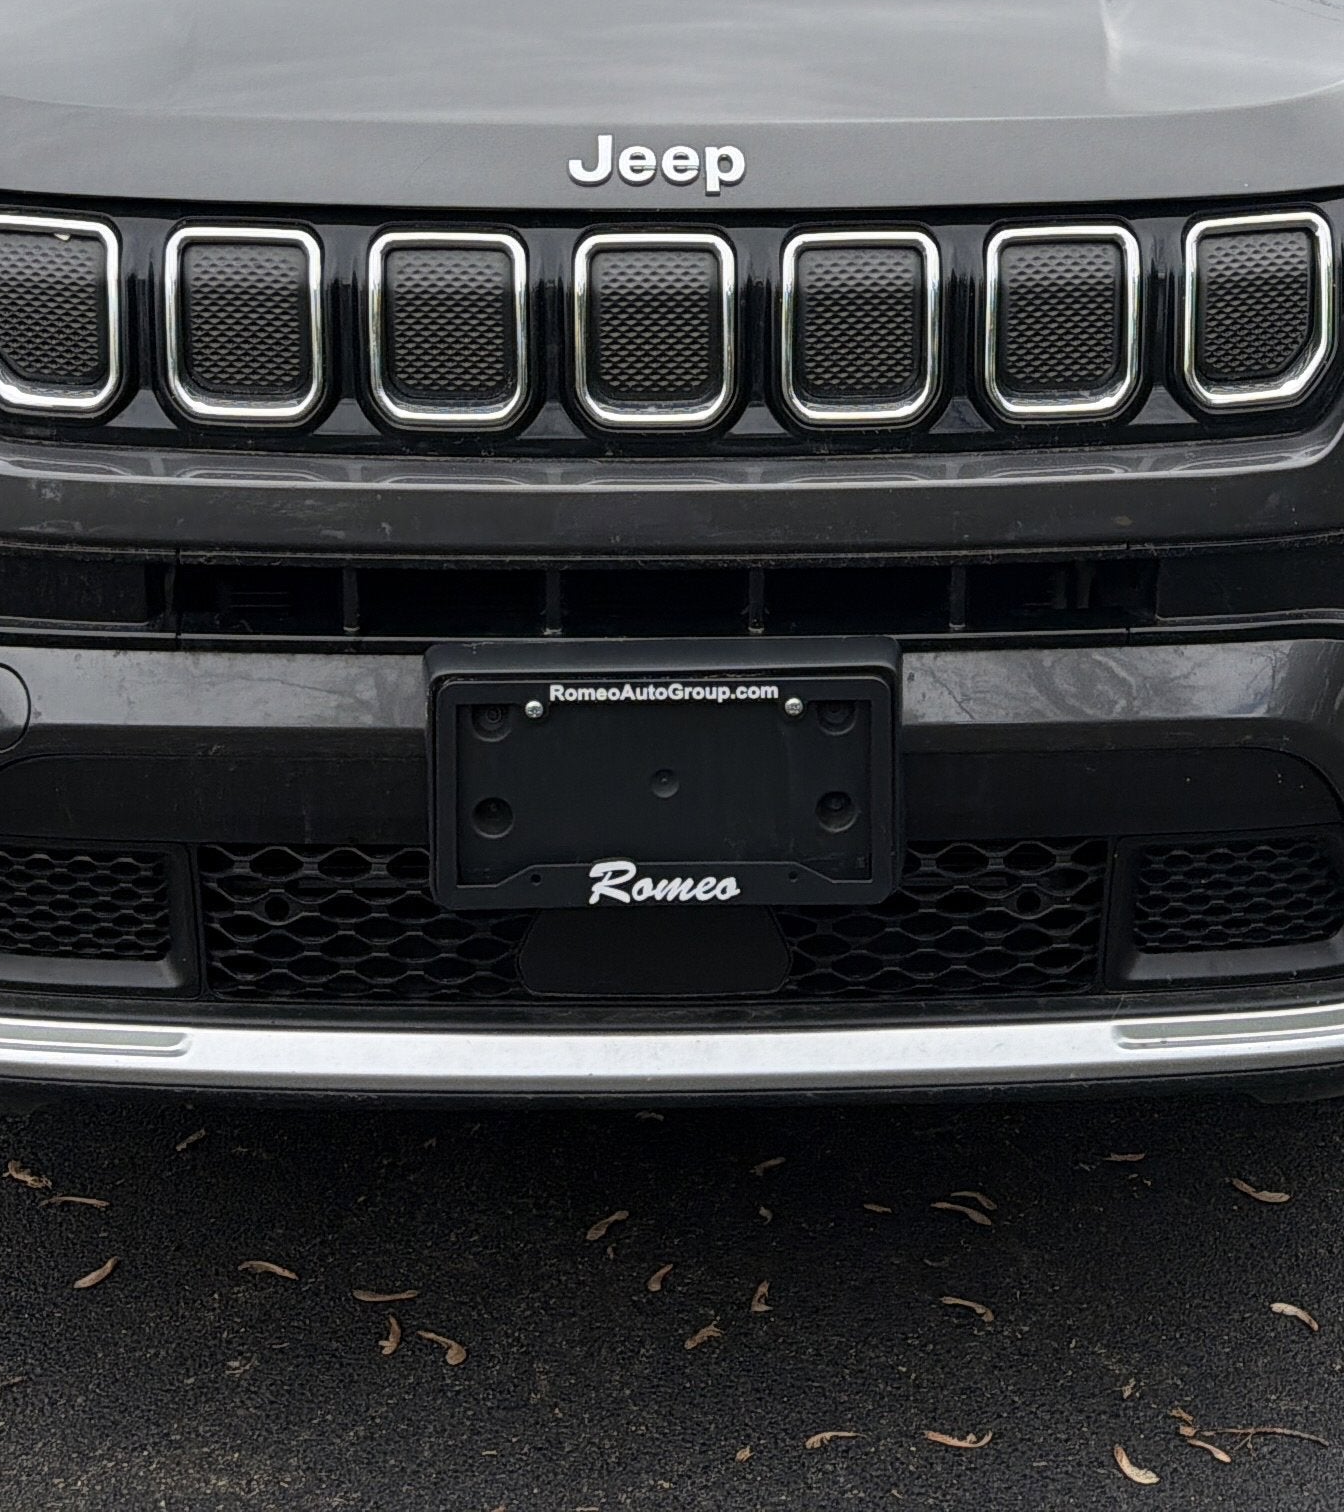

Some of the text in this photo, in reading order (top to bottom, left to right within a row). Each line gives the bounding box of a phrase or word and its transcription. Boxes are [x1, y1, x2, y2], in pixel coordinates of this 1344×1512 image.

[568, 134, 746, 196] Jeep
[549, 683, 779, 703] RomeoAutoGroup.com
[588, 860, 741, 904] Romeo
